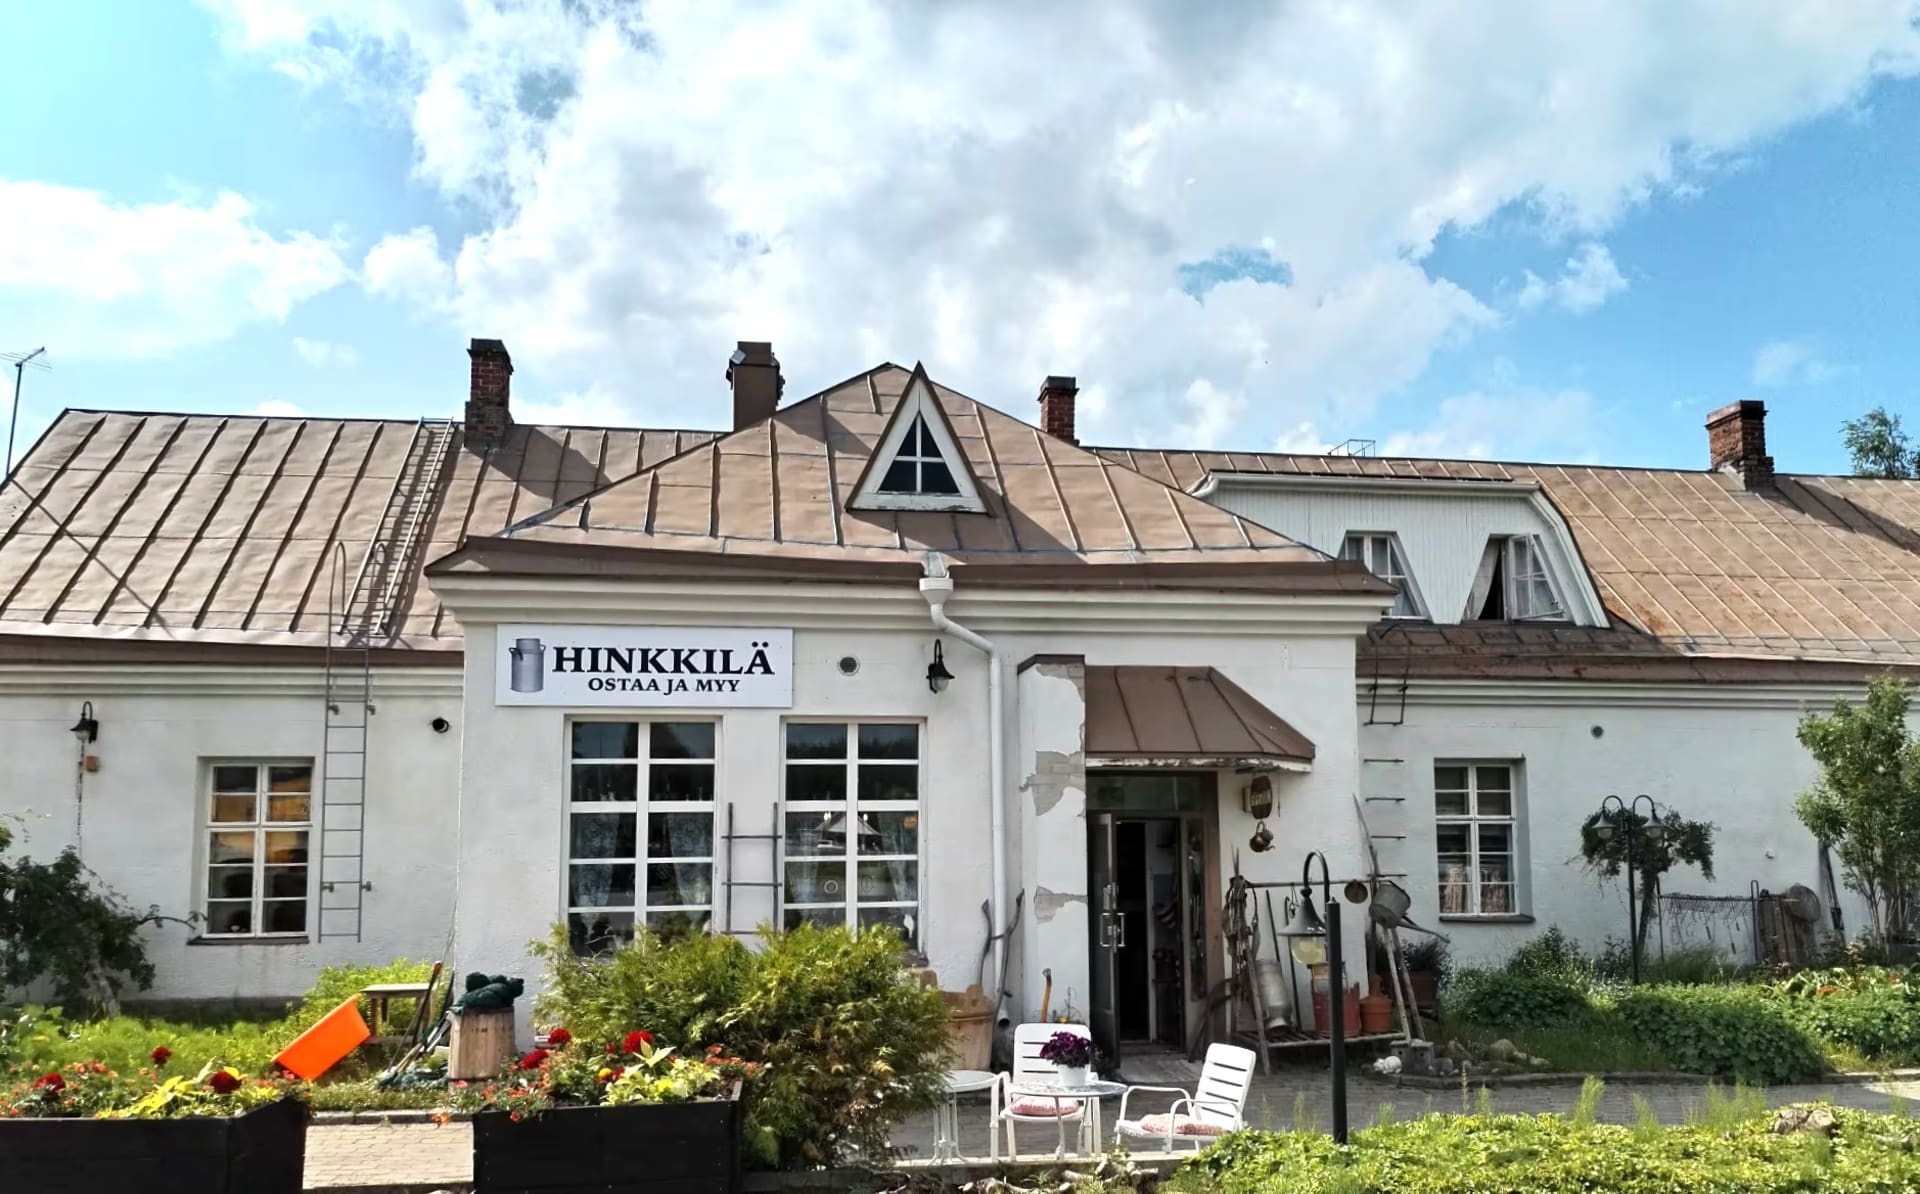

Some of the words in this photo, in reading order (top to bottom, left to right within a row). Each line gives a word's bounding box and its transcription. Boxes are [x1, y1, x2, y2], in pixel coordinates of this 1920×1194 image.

[552, 641, 775, 675] HINKKILÄ
[588, 677, 660, 692] OSTAA
[663, 678, 689, 696] JA
[695, 679, 741, 693] MYY
